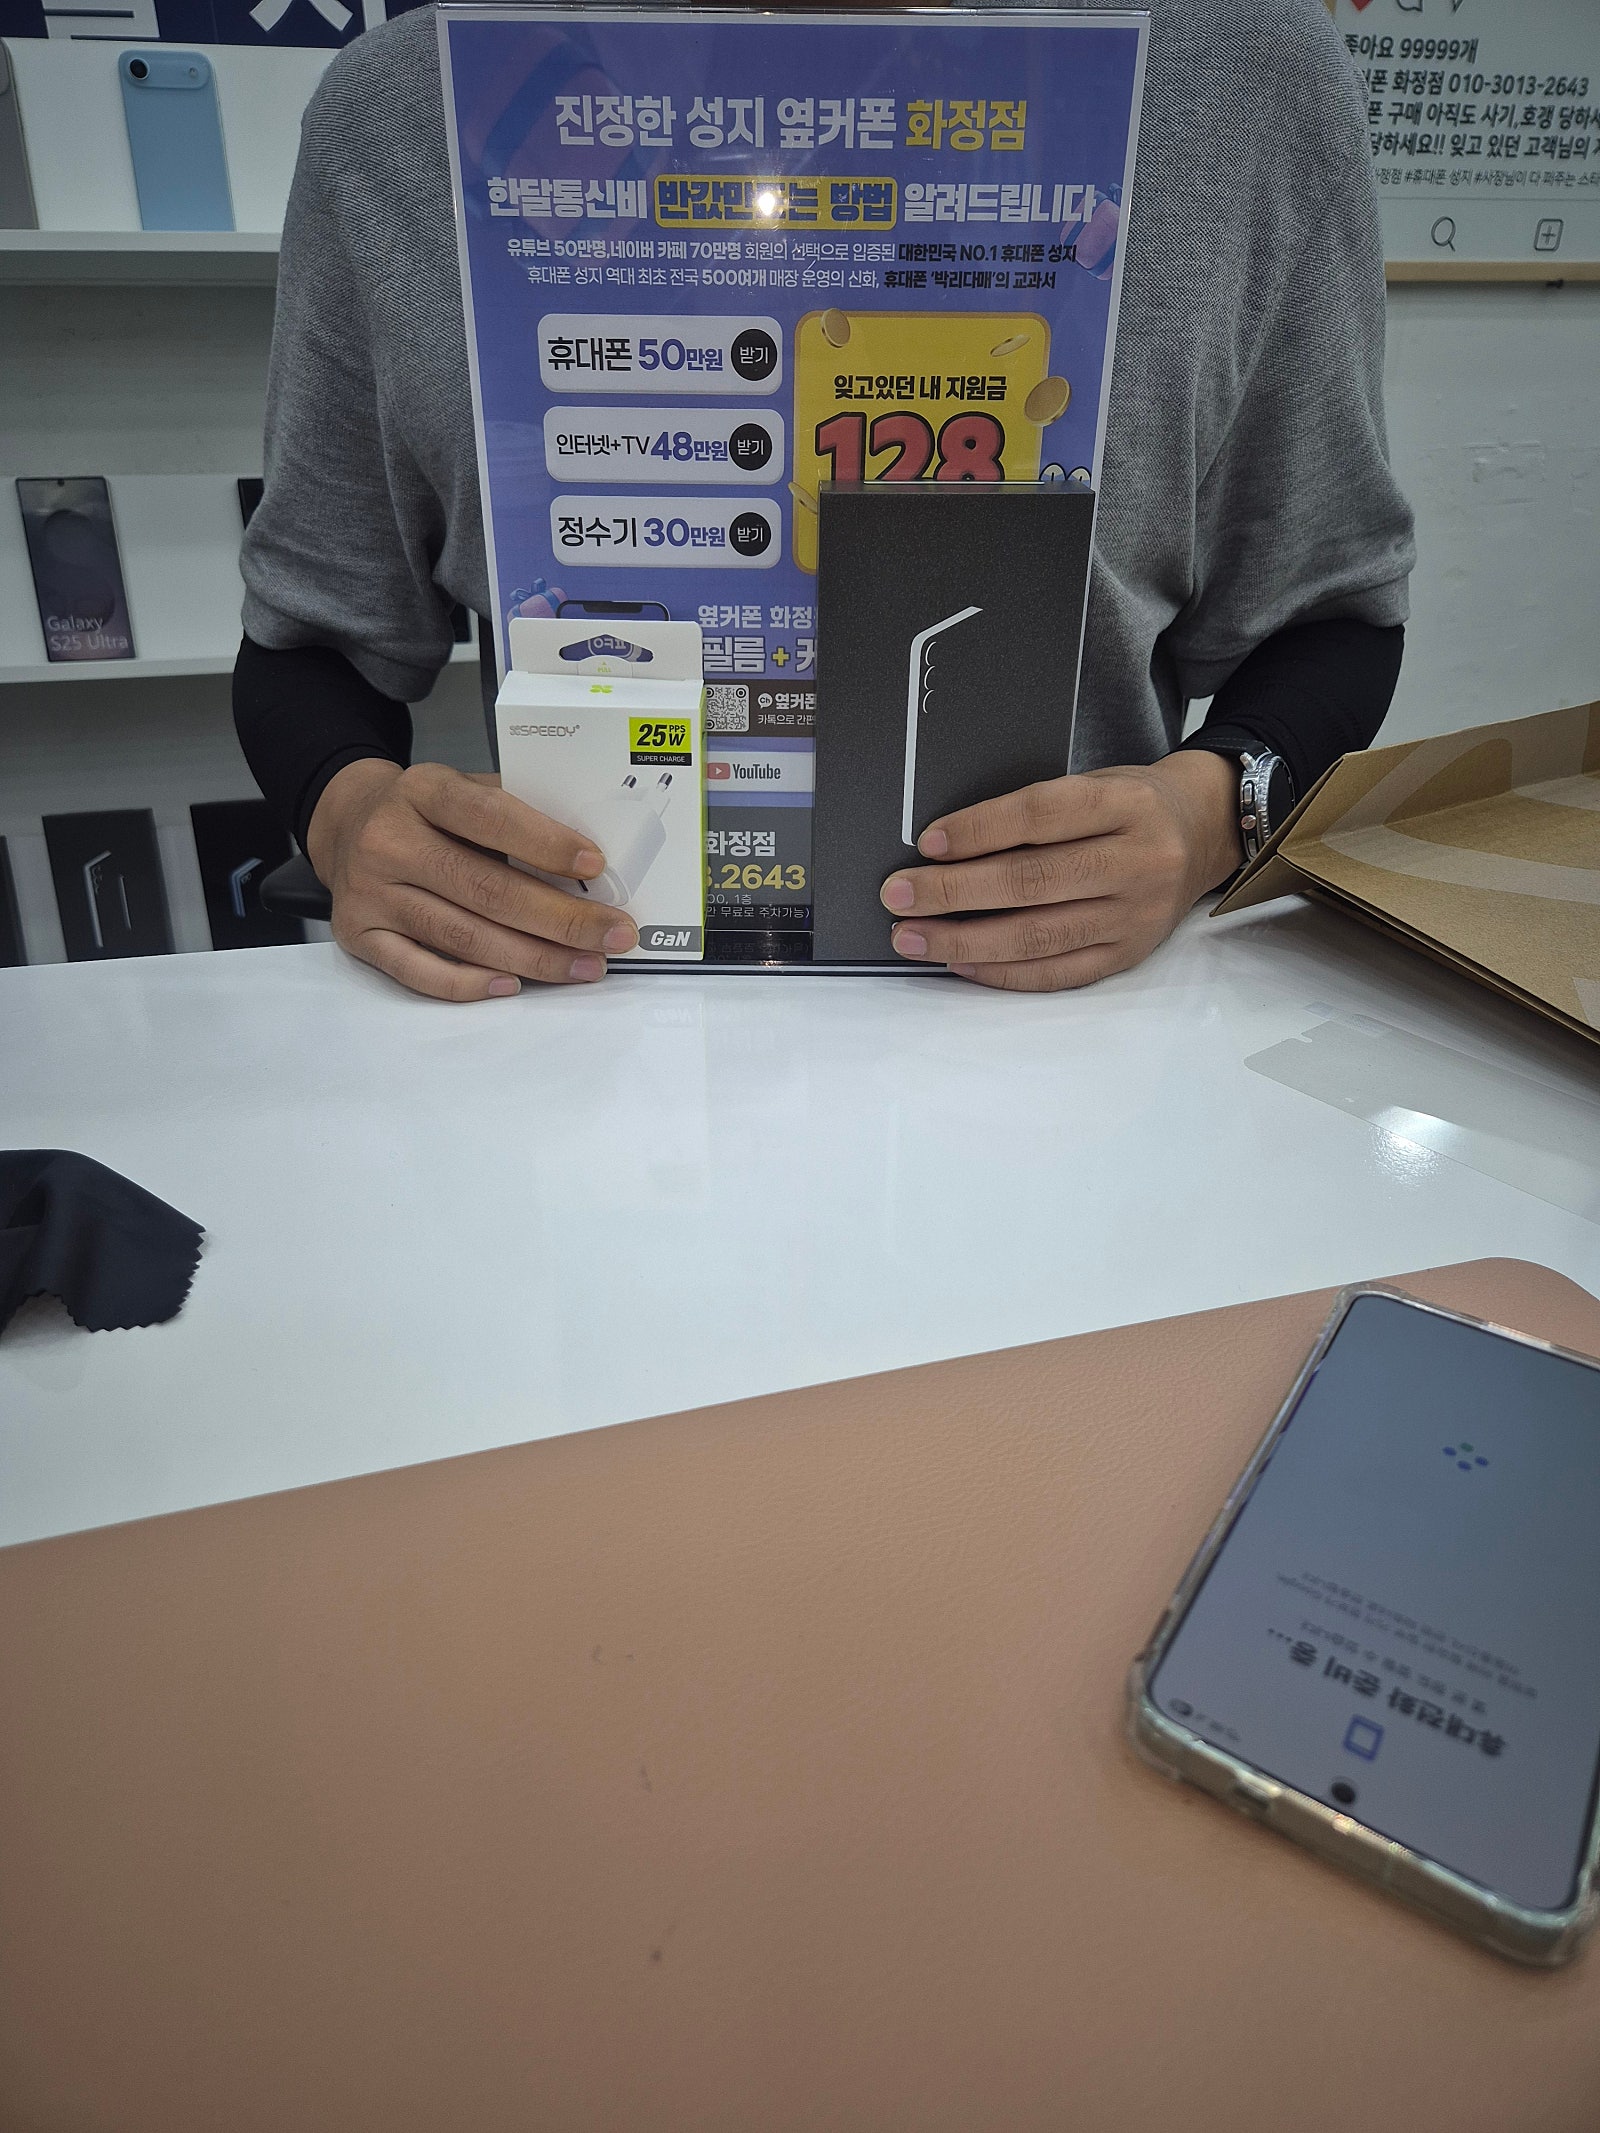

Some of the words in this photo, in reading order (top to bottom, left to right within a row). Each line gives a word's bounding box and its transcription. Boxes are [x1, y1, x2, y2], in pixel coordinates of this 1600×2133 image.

[1399, 37, 1478, 64] 99999개
[1392, 69, 1445, 96] 화정점
[1449, 72, 1590, 97] 010-3013-2643
[555, 95, 677, 147] 진정한
[686, 96, 765, 148] 성지
[776, 97, 897, 150] 옆커폰
[905, 99, 1028, 151] 화정점
[1388, 101, 1423, 126] 구매
[1427, 102, 1477, 127] 아직도
[1481, 103, 1555, 129] 사기,호갱
[1450, 133, 1482, 157] 잊고
[1487, 134, 1521, 158] 있던
[1524, 135, 1591, 160] 고객님의
[487, 176, 648, 219] 한달통신비
[831, 183, 892, 222] 방법
[904, 183, 1097, 224] 알려드립니다
[507, 238, 551, 257] 유튜브
[657, 241, 687, 260] 카페
[691, 241, 741, 261] 70만명
[744, 242, 788, 261] 회원의
[791, 243, 848, 262] 선택으로
[852, 243, 895, 262] 입증된
[898, 244, 957, 263] 대한민국
[959, 245, 997, 262] NO.1
[1000, 244, 1046, 263] 휴대폰
[1048, 245, 1076, 263] 성지
[527, 265, 571, 285] 휴대폰
[574, 266, 603, 285] 성지
[605, 267, 635, 286] 역대
[638, 267, 667, 286] 최초
[669, 268, 699, 287] 전국
[701, 268, 767, 288] 500여개
[769, 269, 798, 288] 매장
[801, 269, 844, 289] 운영의
[848, 270, 880, 290] 신화,
[884, 270, 927, 289] 휴대폰
[1012, 272, 1056, 290] 교과서
[547, 336, 632, 371] 휴대폰
[638, 338, 724, 371] 50만원
[740, 346, 769, 364] 받기
[833, 374, 915, 400] 잊고있던
[919, 375, 941, 400] 내
[946, 375, 1007, 401] 지원금
[556, 433, 650, 457] 인터넷+TV
[650, 431, 729, 462] 48만원
[736, 439, 765, 456] 받기
[815, 410, 1006, 483] 128
[557, 516, 638, 548] 정수기
[643, 517, 726, 548] 30만원
[736, 526, 763, 543] 받기
[47, 614, 104, 634] Galaxy
[698, 605, 762, 629] 옆커폰
[769, 605, 816, 629] 화정
[50, 633, 82, 651] S25
[87, 634, 129, 650] Ultra
[669, 724, 686, 733] PPS
[757, 714, 795, 725] 카톡으로
[637, 755, 659, 763] SUPER
[659, 755, 686, 763] CHARGE
[732, 763, 782, 780] YouTube
[734, 893, 752, 905] 1층
[720, 906, 755, 917] 무료로
[759, 907, 811, 918] 주차가능)
[650, 930, 691, 947] GaN
